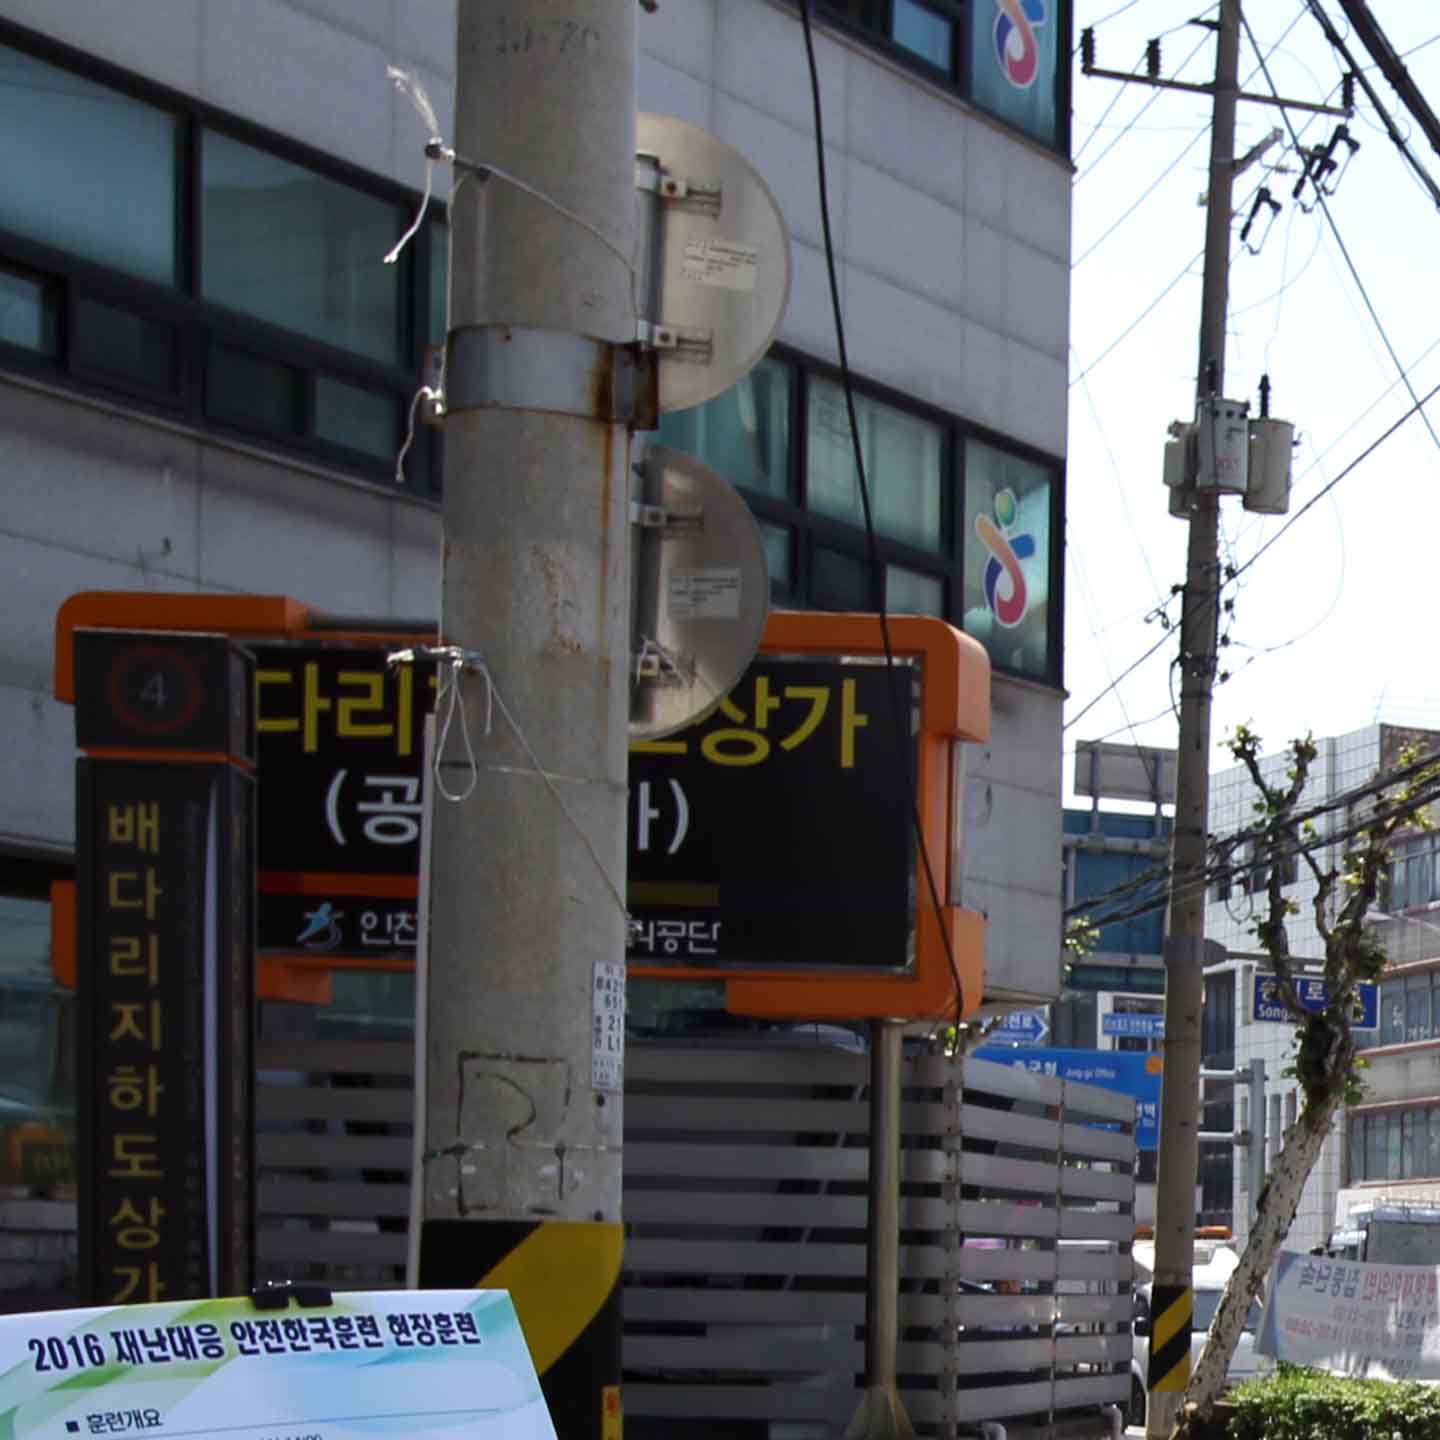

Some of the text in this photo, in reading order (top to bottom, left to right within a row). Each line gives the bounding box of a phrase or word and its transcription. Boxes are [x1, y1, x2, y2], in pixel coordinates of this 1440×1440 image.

[28, 1312, 481, 1372] 2016 재난대응 안전한국훈련 현장훈련
[86, 1408, 163, 1434] 훈련개요
